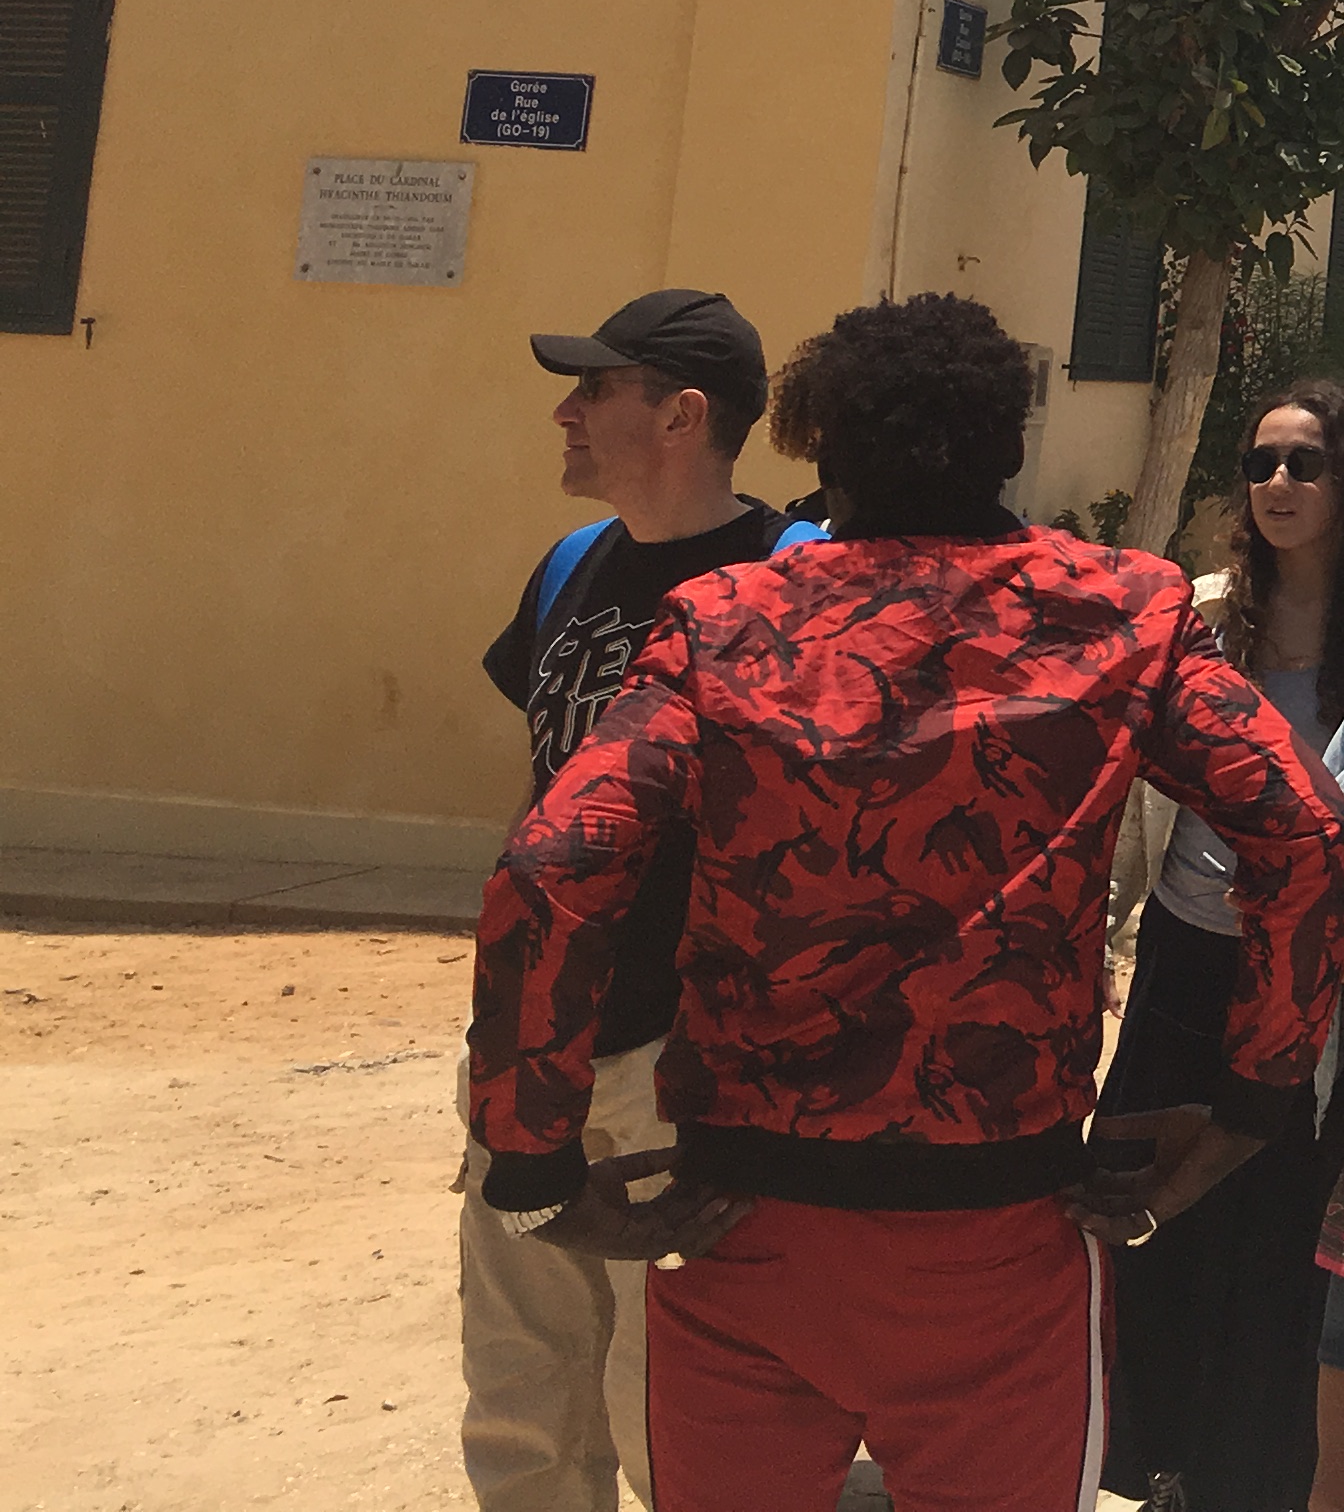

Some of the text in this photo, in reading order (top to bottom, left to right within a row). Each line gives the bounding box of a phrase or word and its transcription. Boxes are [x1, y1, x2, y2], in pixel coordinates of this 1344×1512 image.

[510, 80, 548, 93] Gorée
[514, 95, 539, 108] Rue
[491, 109, 560, 125] de l'église
[497, 123, 550, 139] (GO-19)
[334, 174, 441, 187] PLACE DU CARDINAL
[320, 189, 453, 203] HYACINTHE THIANDOUM
